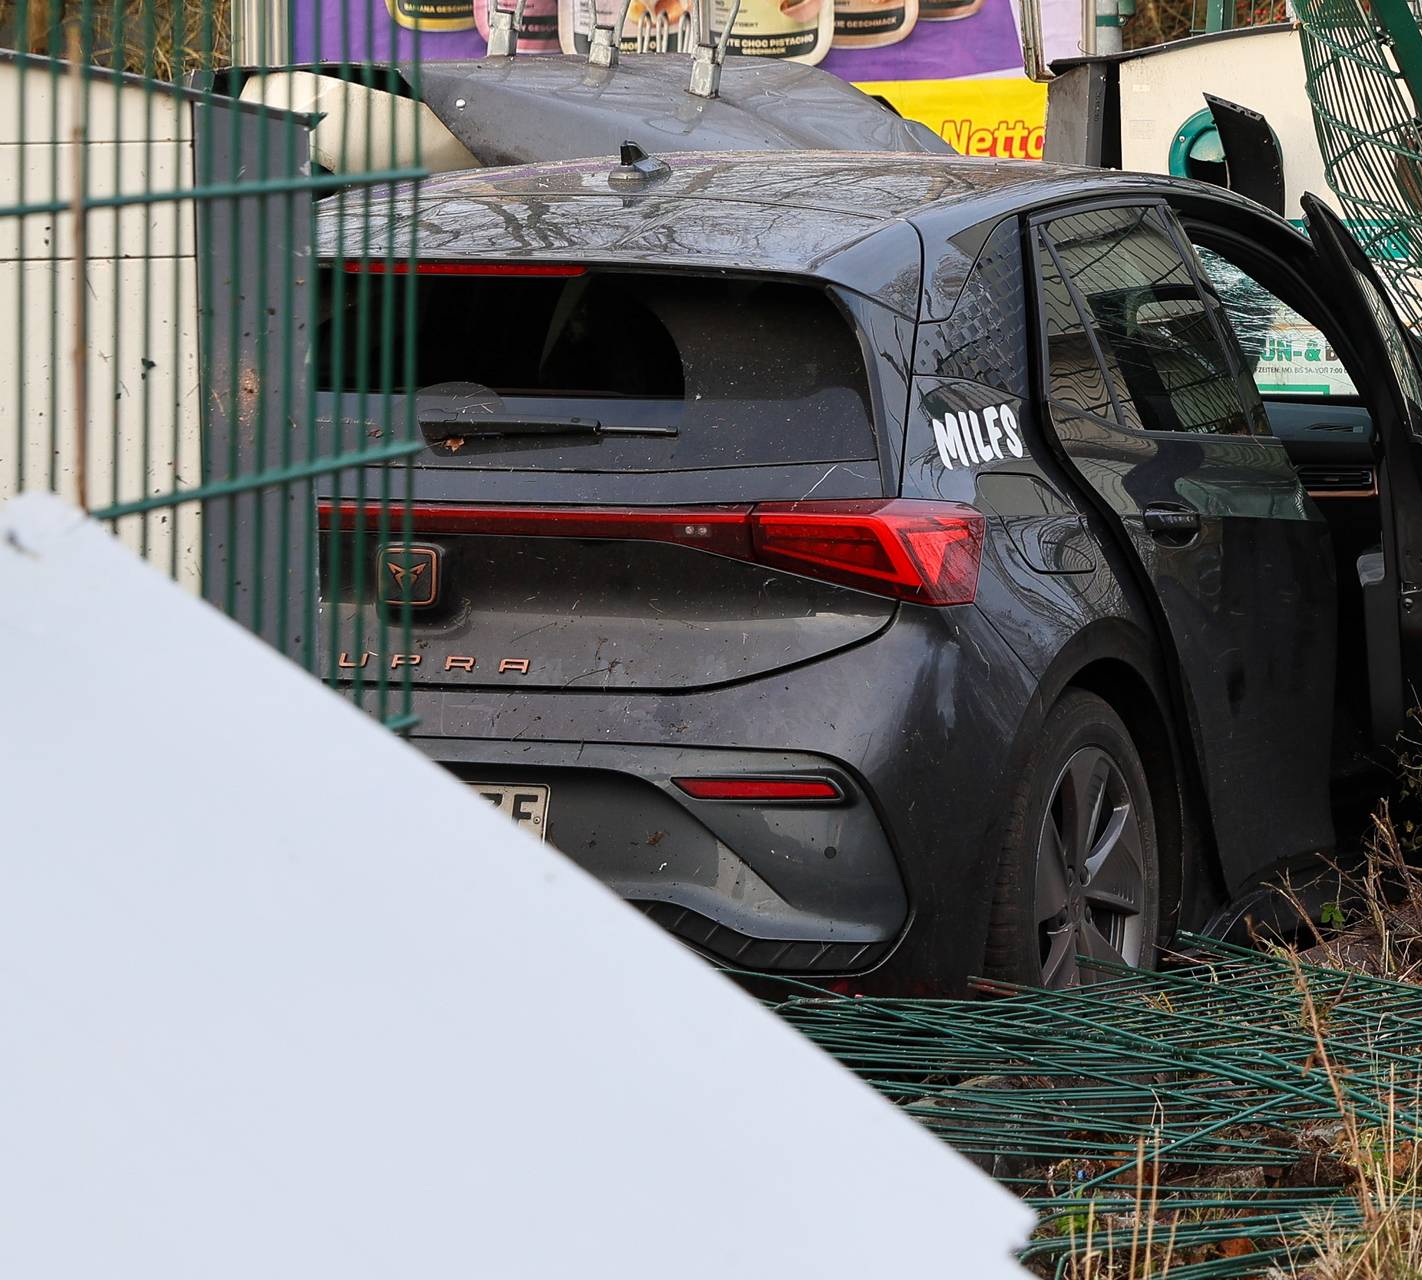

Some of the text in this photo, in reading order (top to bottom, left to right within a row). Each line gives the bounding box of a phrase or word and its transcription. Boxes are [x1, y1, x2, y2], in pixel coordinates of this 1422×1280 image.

[846, 16, 897, 28] GESCHMACK
[741, 39, 769, 48] CHOC
[769, 34, 814, 47] PISTACHIO
[941, 120, 1045, 160] Netto
[932, 404, 1023, 470] MILFS
[338, 652, 531, 675] UPRA
